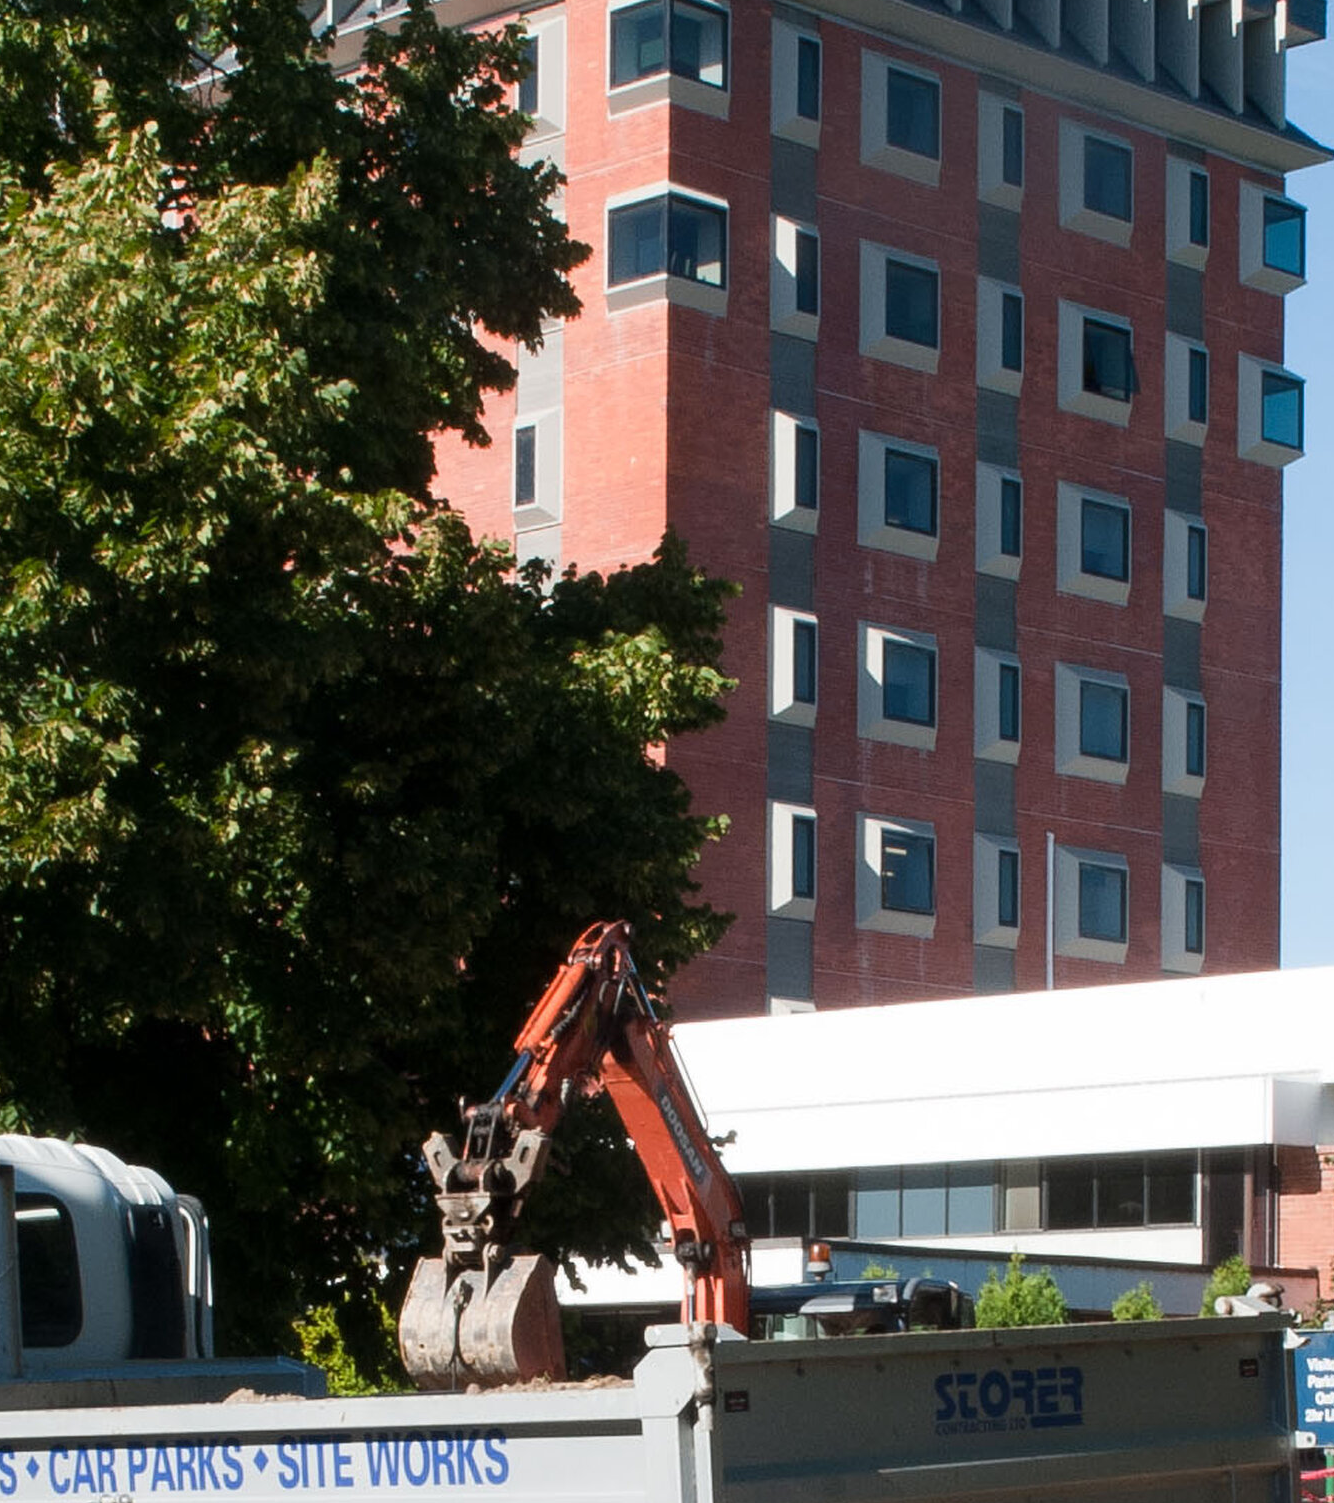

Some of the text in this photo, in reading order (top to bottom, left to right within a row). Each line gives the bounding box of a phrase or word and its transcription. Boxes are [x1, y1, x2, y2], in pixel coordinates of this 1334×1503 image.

[660, 1094, 704, 1177] DOOSAN
[933, 1366, 1084, 1422] STORER
[49, 1441, 117, 1494] CAR
[127, 1436, 244, 1492] PARKS
[276, 1434, 354, 1489] SITE
[363, 1428, 510, 1487] WORKS
